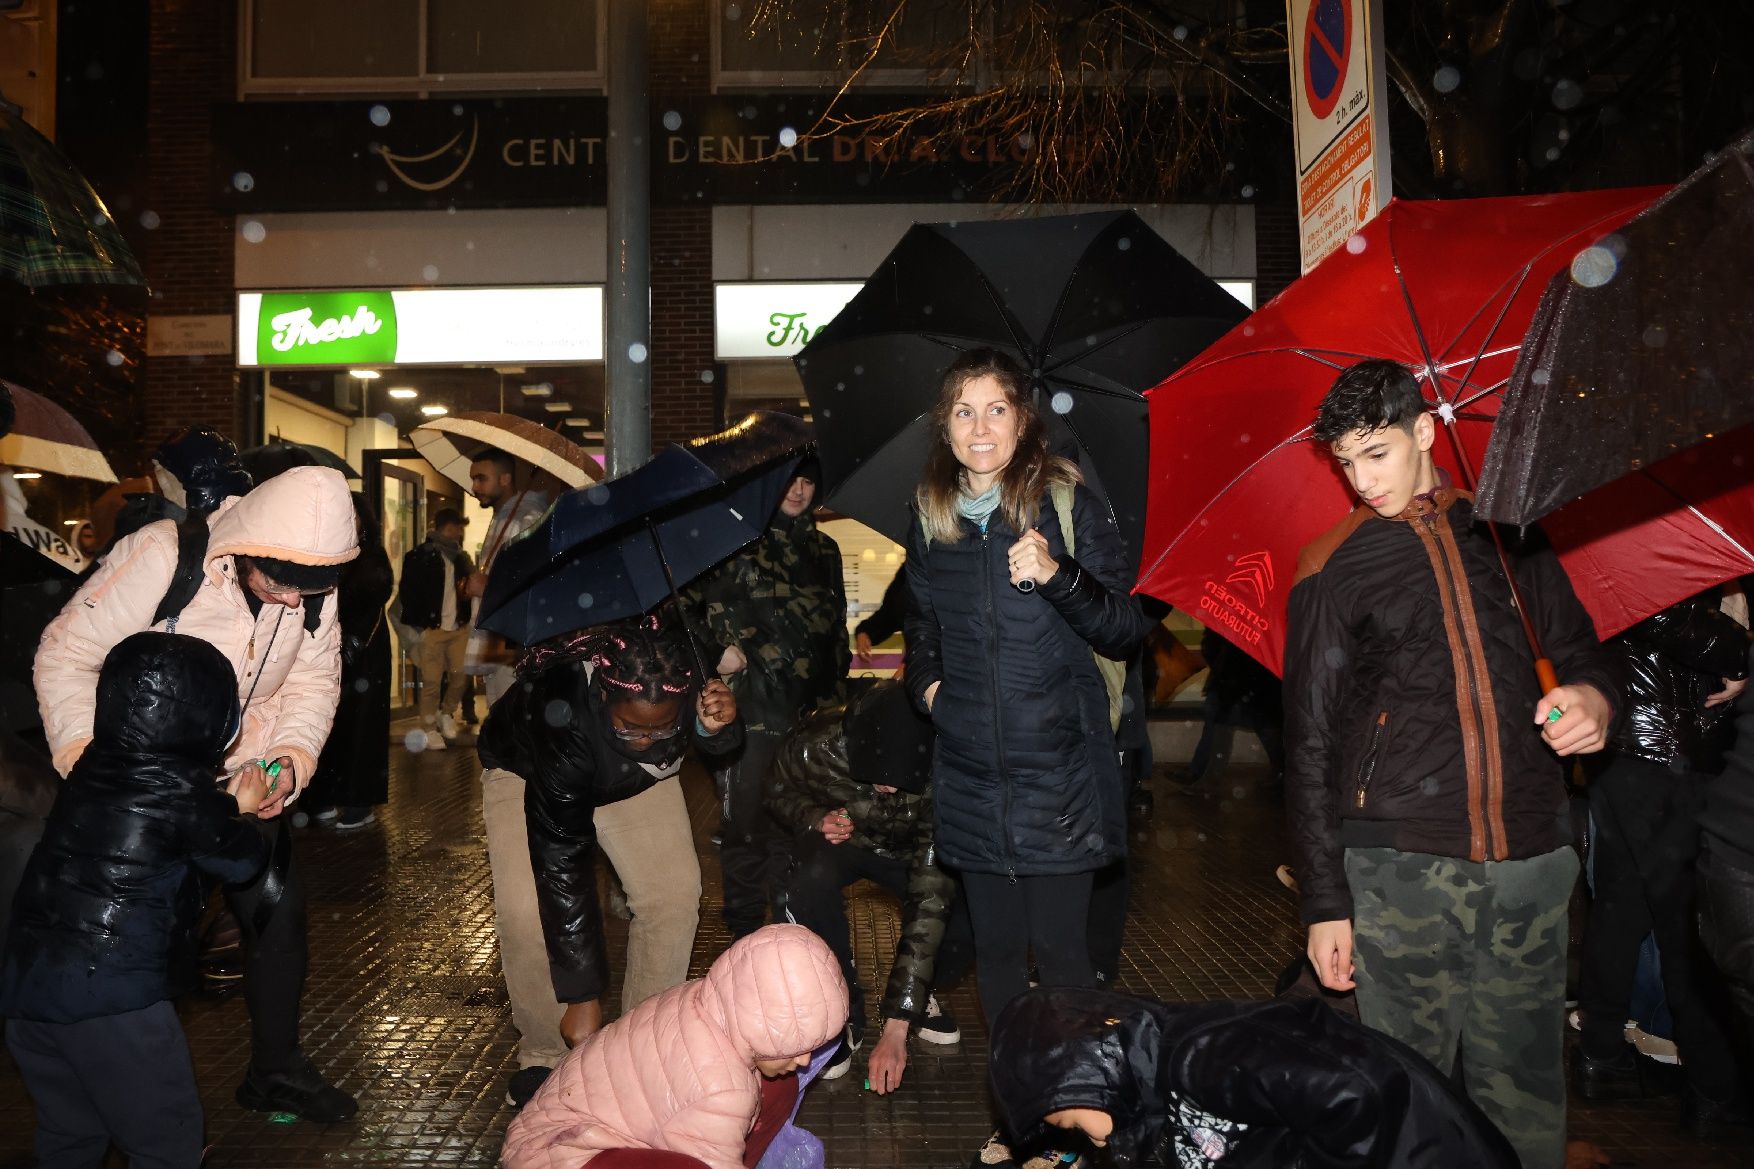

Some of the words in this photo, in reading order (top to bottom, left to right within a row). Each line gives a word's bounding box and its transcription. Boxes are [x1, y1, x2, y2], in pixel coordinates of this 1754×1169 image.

[1335, 110, 1341, 125] 2
[1341, 106, 1348, 119] h.
[502, 138, 603, 167] CENT
[667, 135, 820, 163] DENTAL
[831, 135, 900, 163] DR.
[271, 305, 382, 351] Fresh
